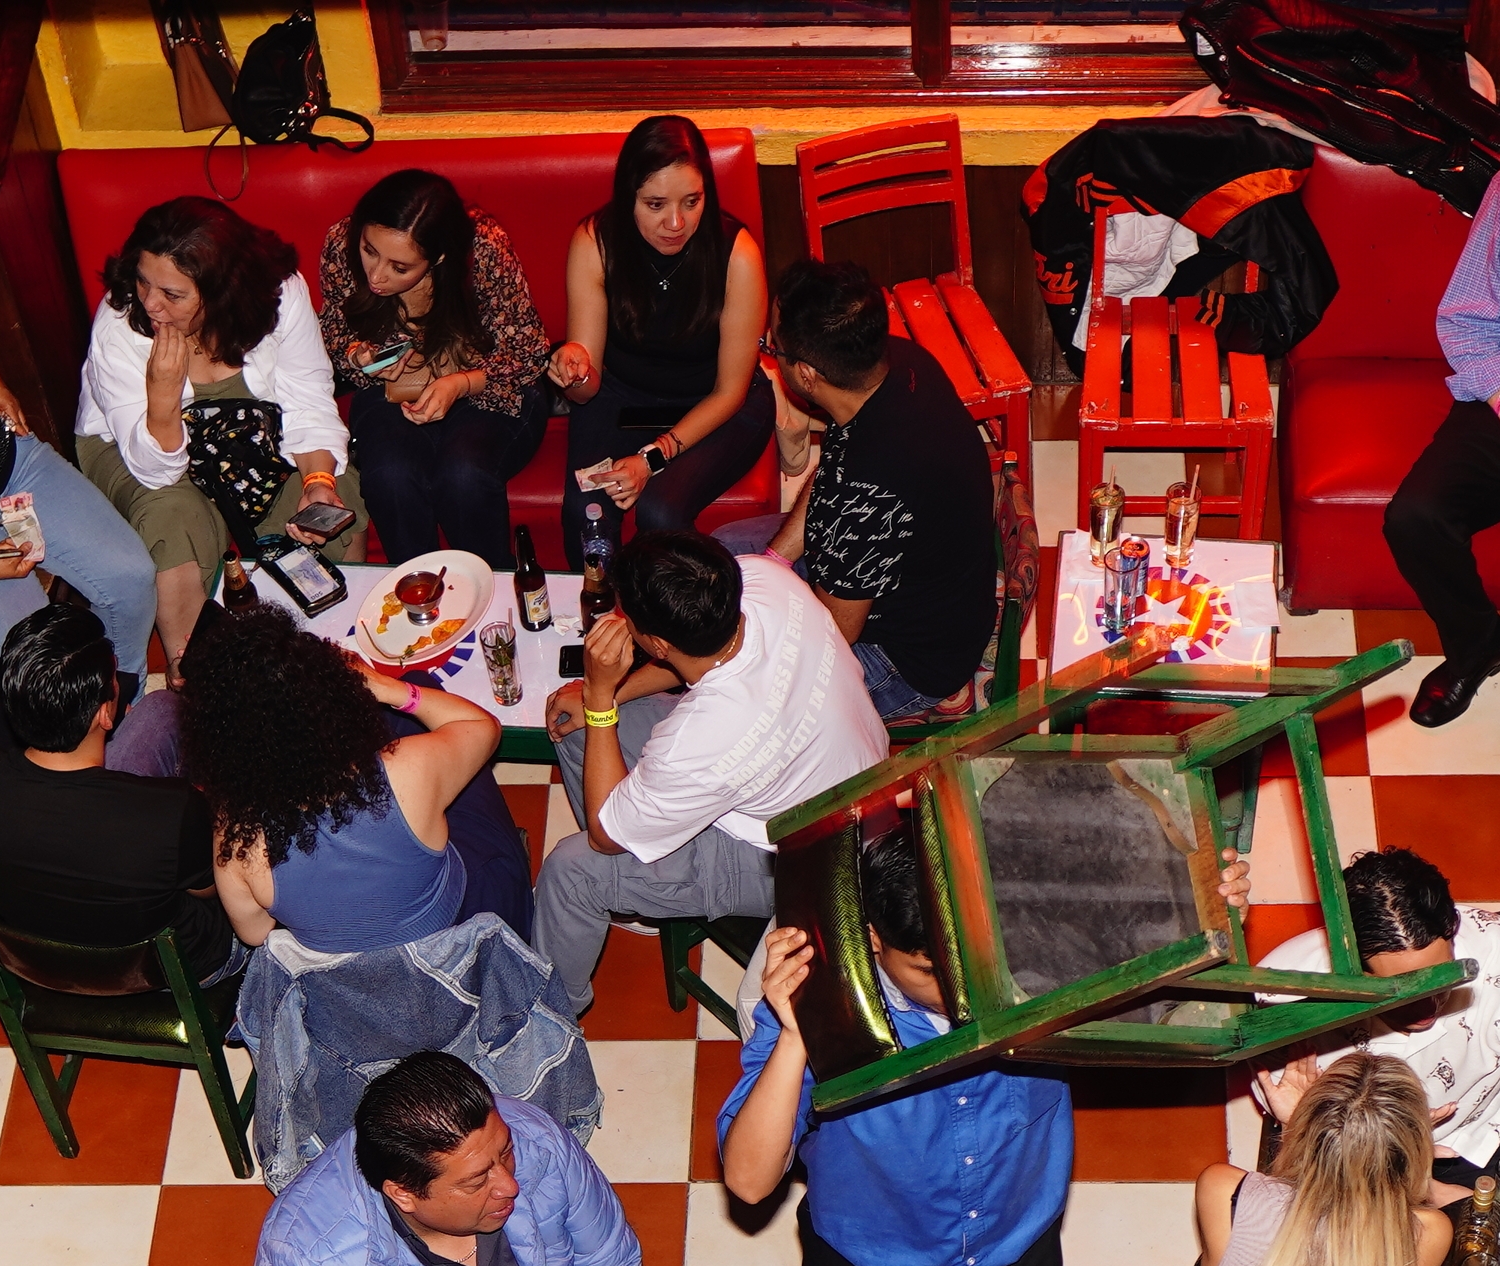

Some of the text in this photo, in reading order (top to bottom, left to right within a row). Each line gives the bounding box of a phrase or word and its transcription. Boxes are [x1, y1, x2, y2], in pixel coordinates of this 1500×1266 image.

[710, 590, 804, 778] MINDFULNESS IN EVERY
[809, 685, 826, 711] IN
[816, 640, 836, 688] EVERY
[726, 724, 791, 792] MOMENT.
[739, 710, 817, 801] SIMPLICITY
